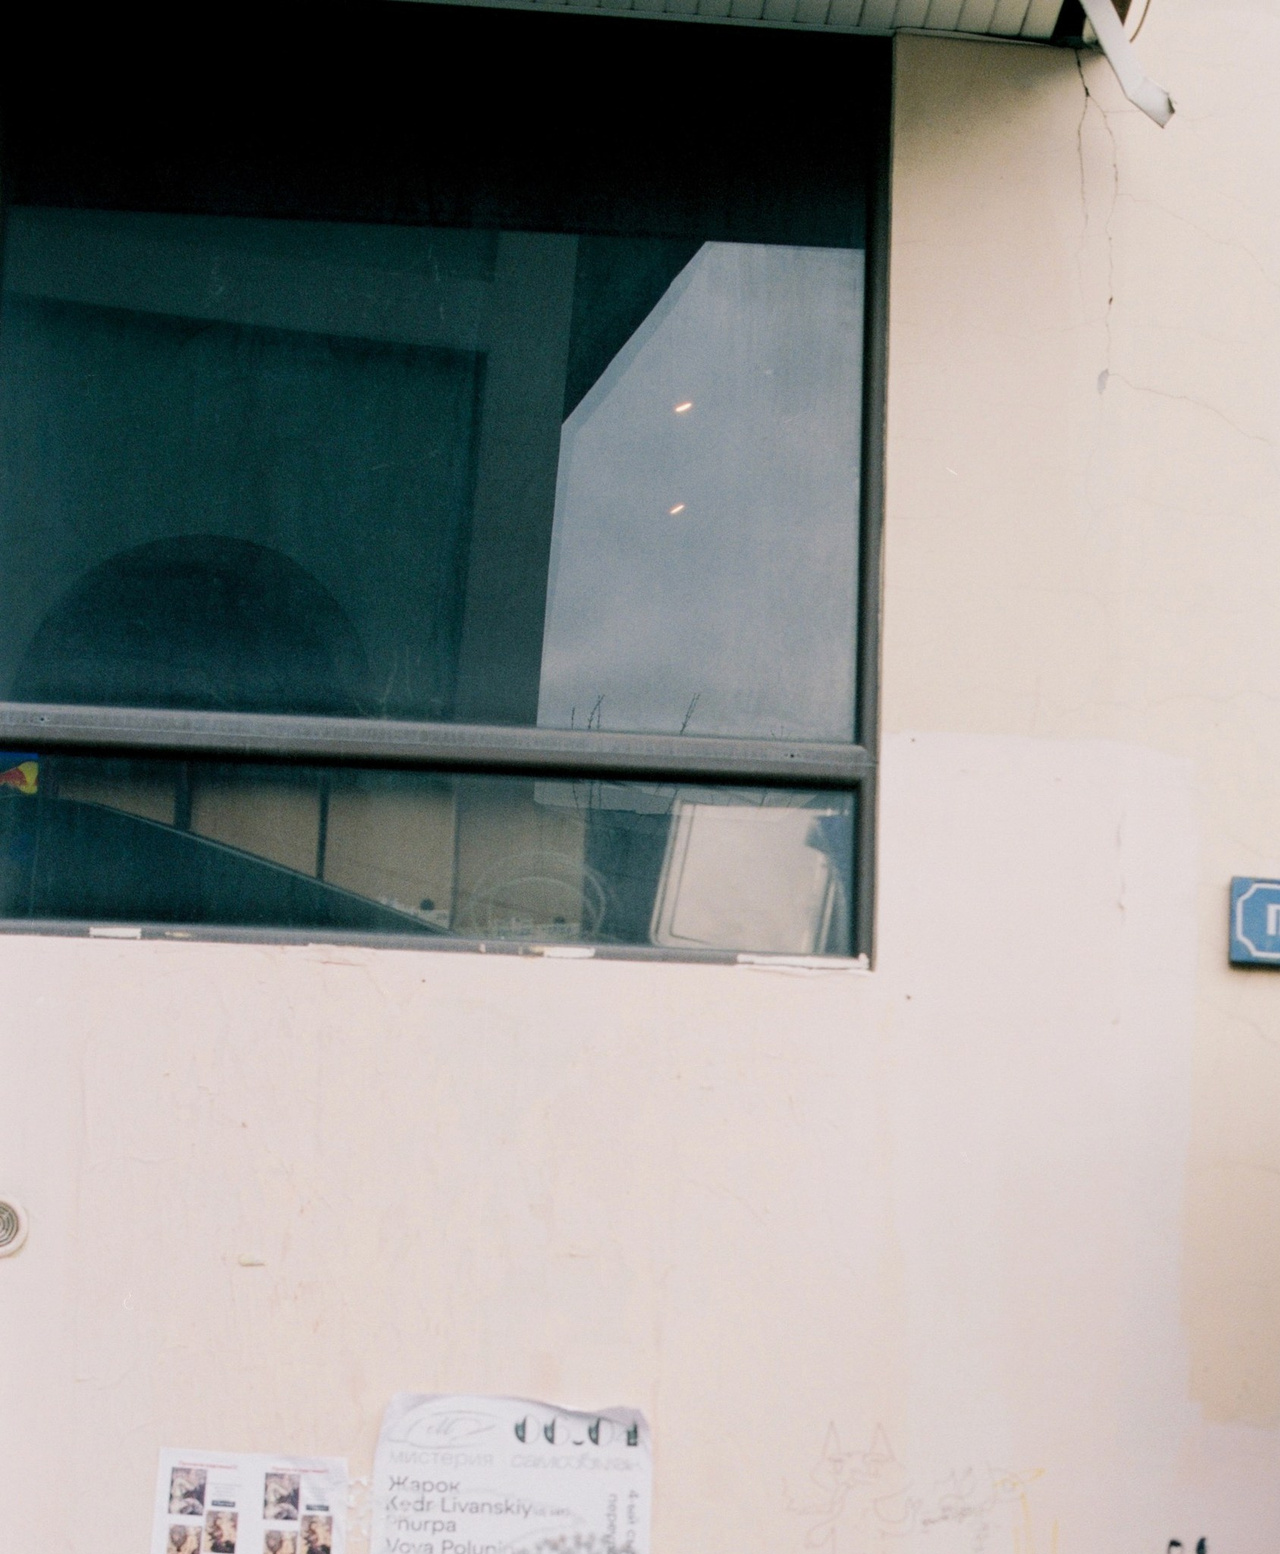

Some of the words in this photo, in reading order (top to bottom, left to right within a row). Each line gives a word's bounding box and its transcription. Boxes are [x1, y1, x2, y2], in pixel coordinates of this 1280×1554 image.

[388, 1475, 461, 1497] Жарок
[386, 1496, 434, 1514] Kedr
[440, 1497, 534, 1519] Livanskiy
